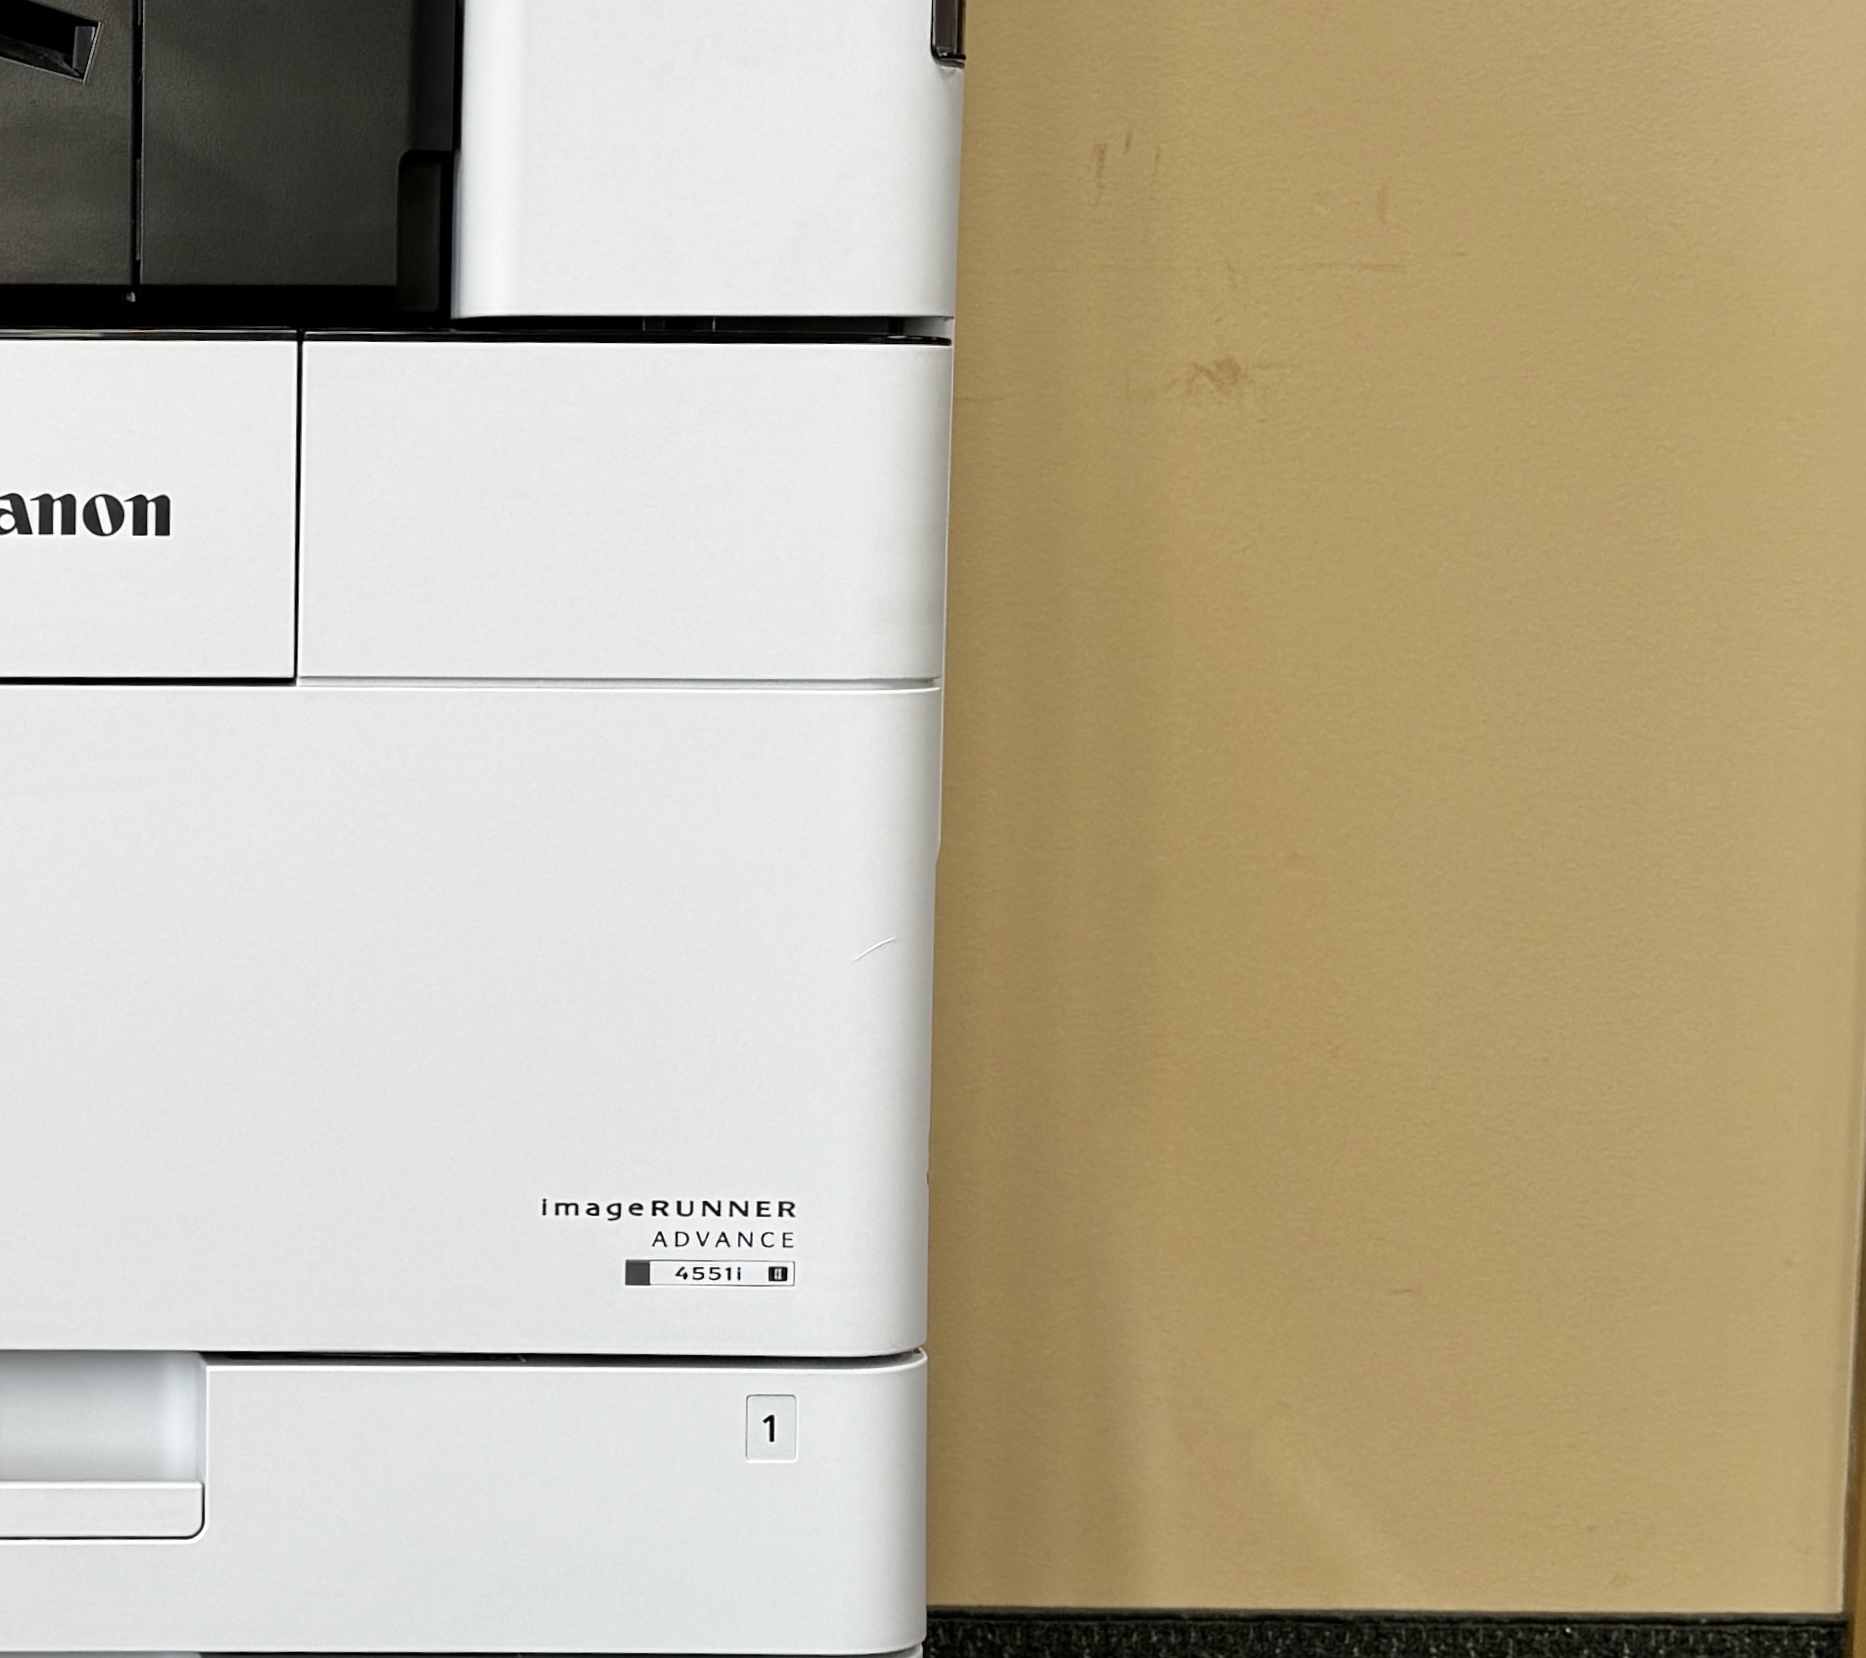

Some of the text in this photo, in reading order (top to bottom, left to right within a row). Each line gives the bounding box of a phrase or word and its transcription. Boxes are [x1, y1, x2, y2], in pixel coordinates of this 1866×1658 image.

[542, 1198, 796, 1222] imageRUNNER
[651, 1230, 794, 1249] ADVANCE
[675, 1266, 742, 1281] 4551i
[762, 1414, 775, 1443] 1
